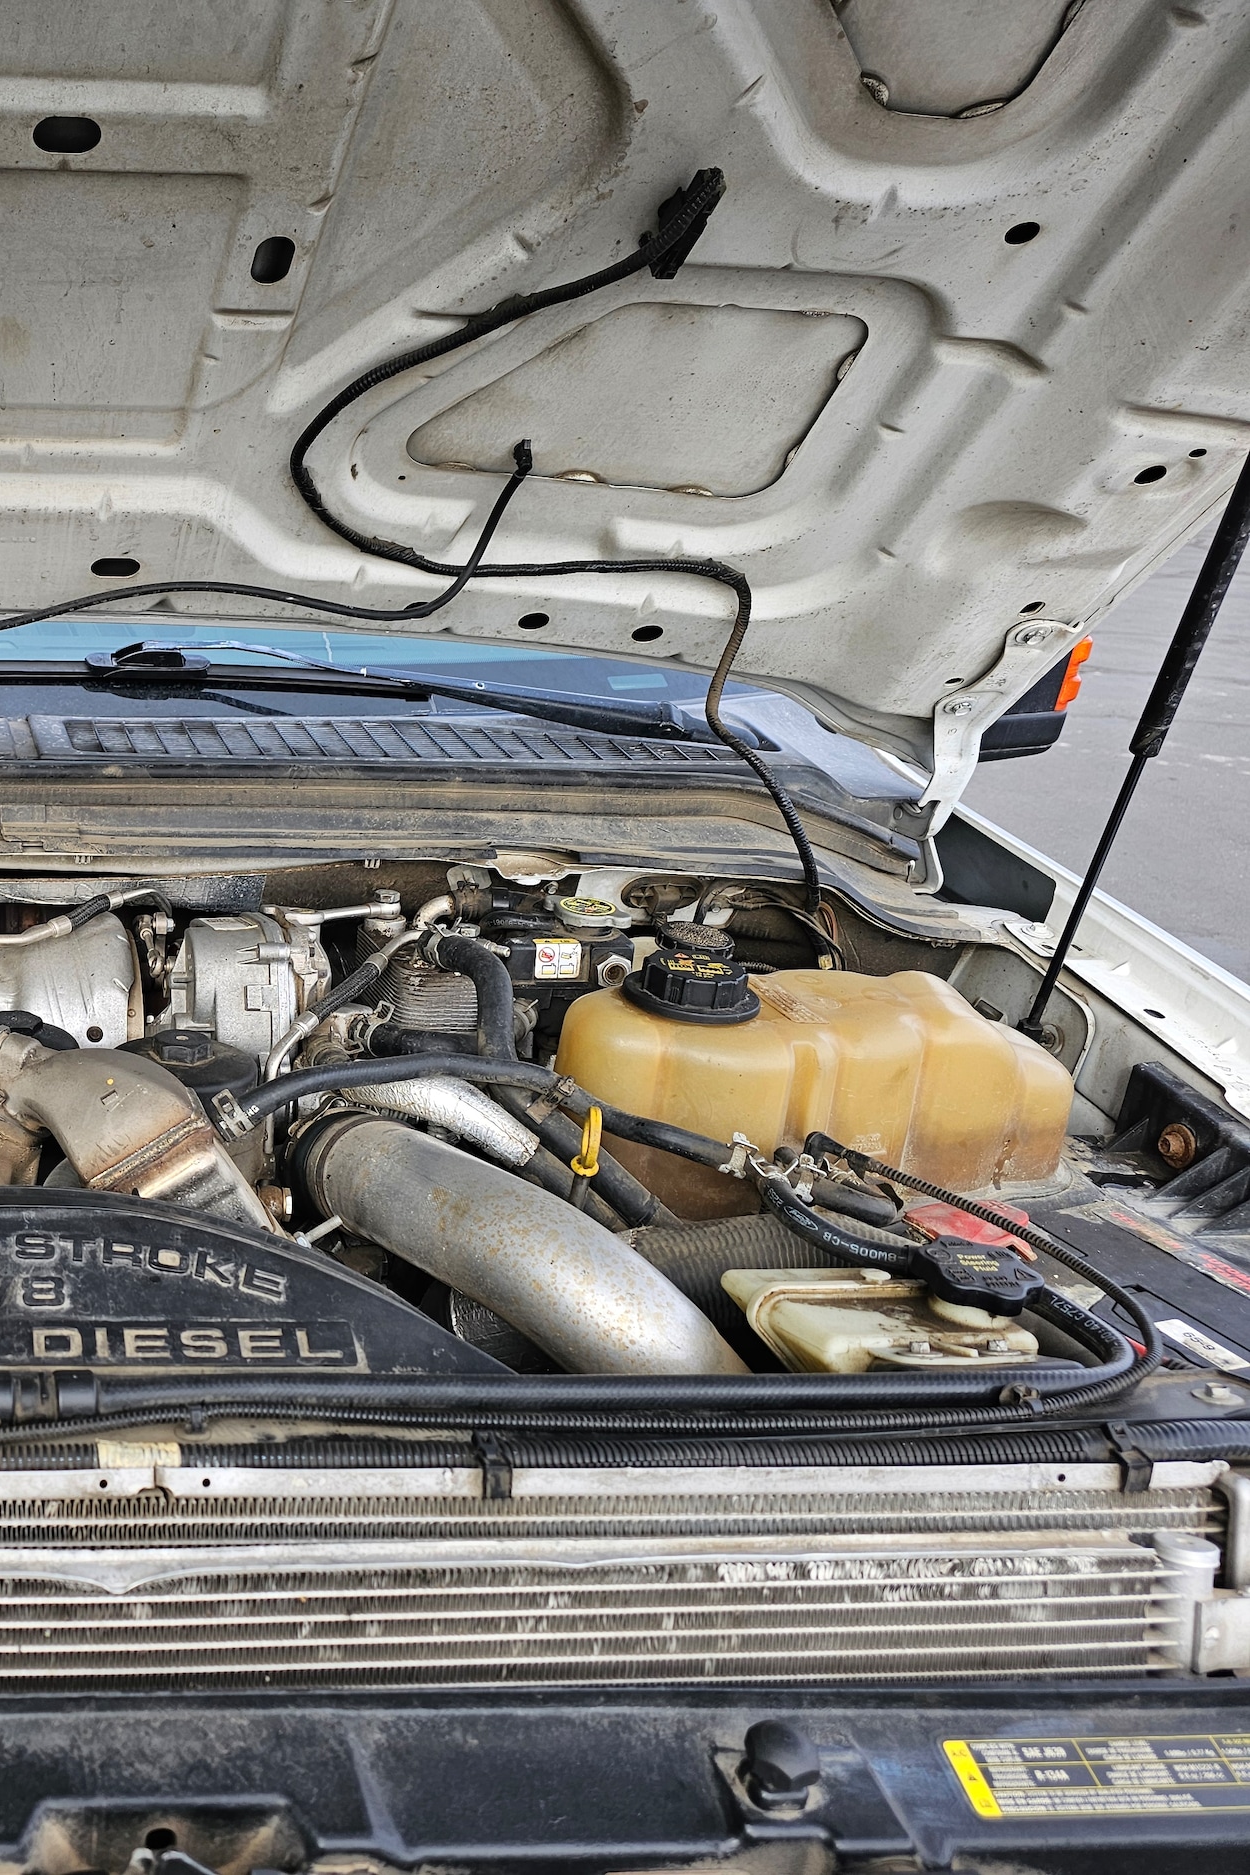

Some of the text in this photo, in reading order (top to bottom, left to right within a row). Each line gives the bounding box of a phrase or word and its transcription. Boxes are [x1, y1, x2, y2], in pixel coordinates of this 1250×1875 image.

[15, 1232, 288, 1302] STROKE
[959, 1259, 1000, 1267] Steering
[33, 1326, 345, 1361] DIESEL
[1182, 1332, 1216, 1351] 65-9
